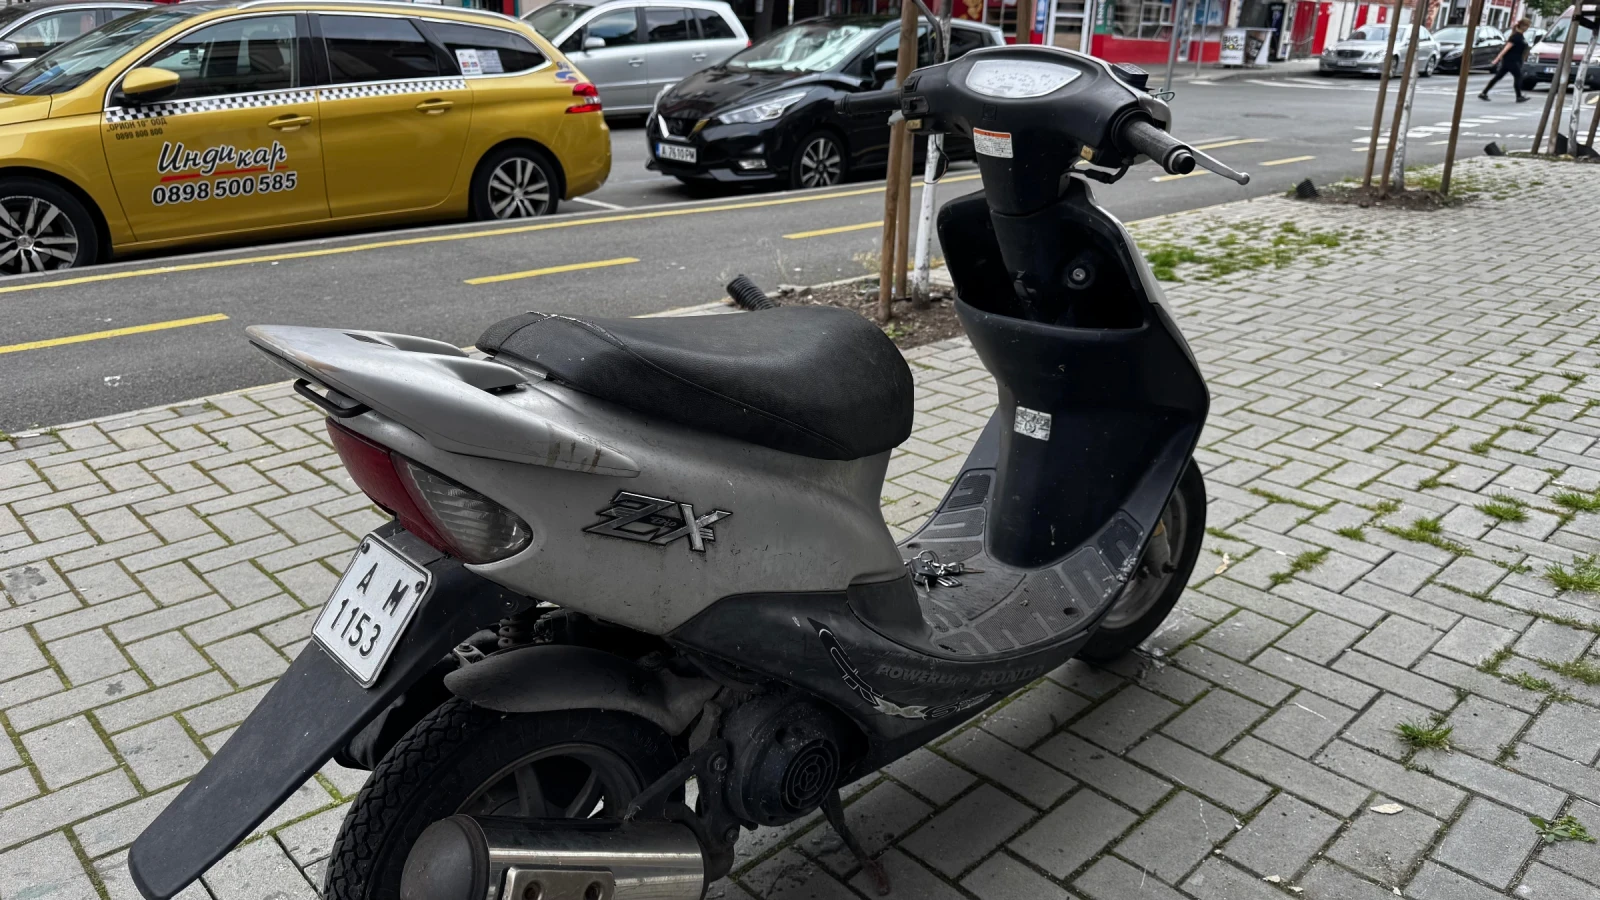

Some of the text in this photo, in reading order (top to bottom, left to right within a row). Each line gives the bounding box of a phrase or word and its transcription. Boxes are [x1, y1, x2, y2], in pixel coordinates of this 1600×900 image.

[152, 171, 297, 206] 0898 500 585
[356, 562, 409, 617] A M
[330, 598, 381, 657] 1153
